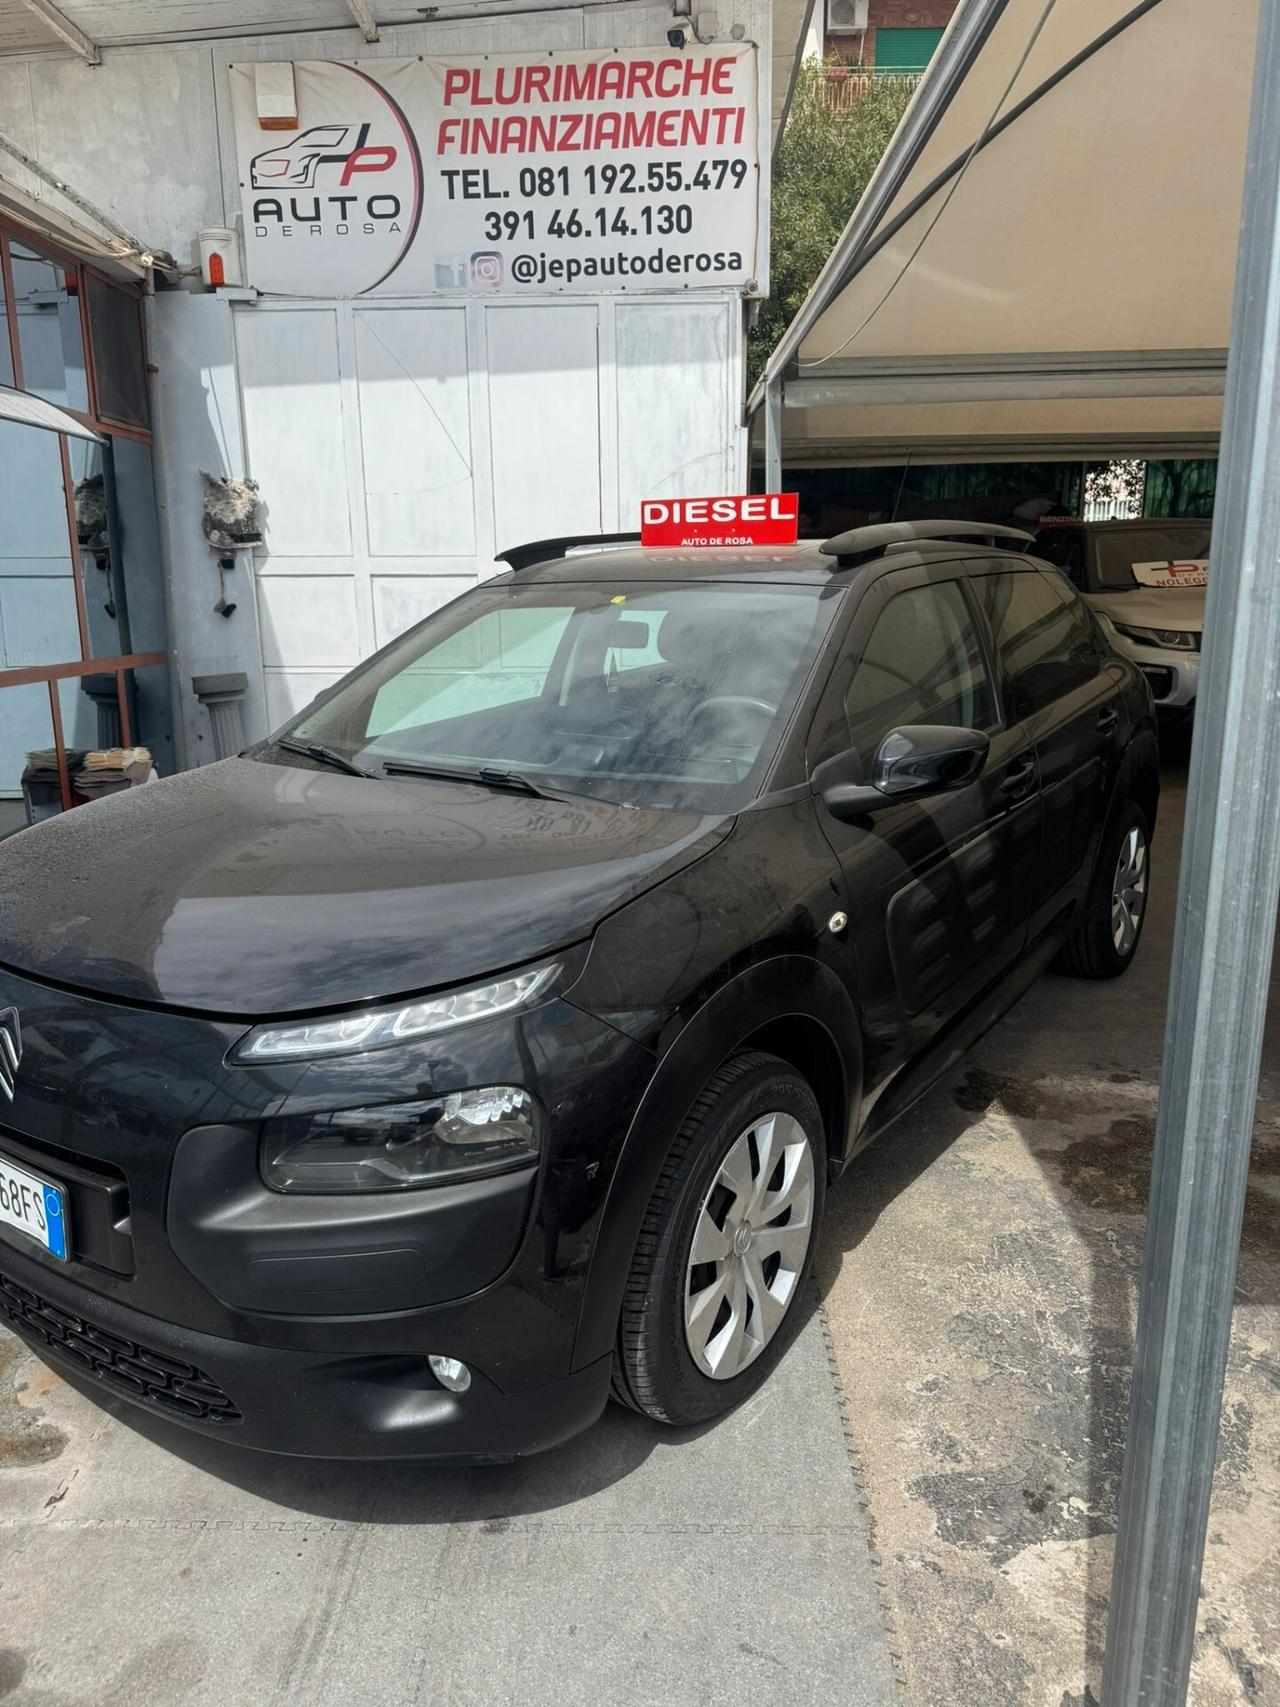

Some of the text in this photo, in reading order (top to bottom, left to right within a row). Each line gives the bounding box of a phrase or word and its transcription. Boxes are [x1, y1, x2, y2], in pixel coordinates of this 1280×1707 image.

[443, 56, 738, 107] PLURIMARCHE
[437, 107, 746, 155] FINANZIAMENTI
[441, 159, 747, 200] TEL. 081 192.55.479
[253, 194, 401, 223] AUTO
[484, 204, 693, 241] 391 46.14.130
[511, 248, 743, 283] @jepautoderosa
[643, 497, 796, 525] DIESEL
[1040, 515, 1083, 523] BENZINA
[681, 536, 754, 546] AUTO DE ROSA
